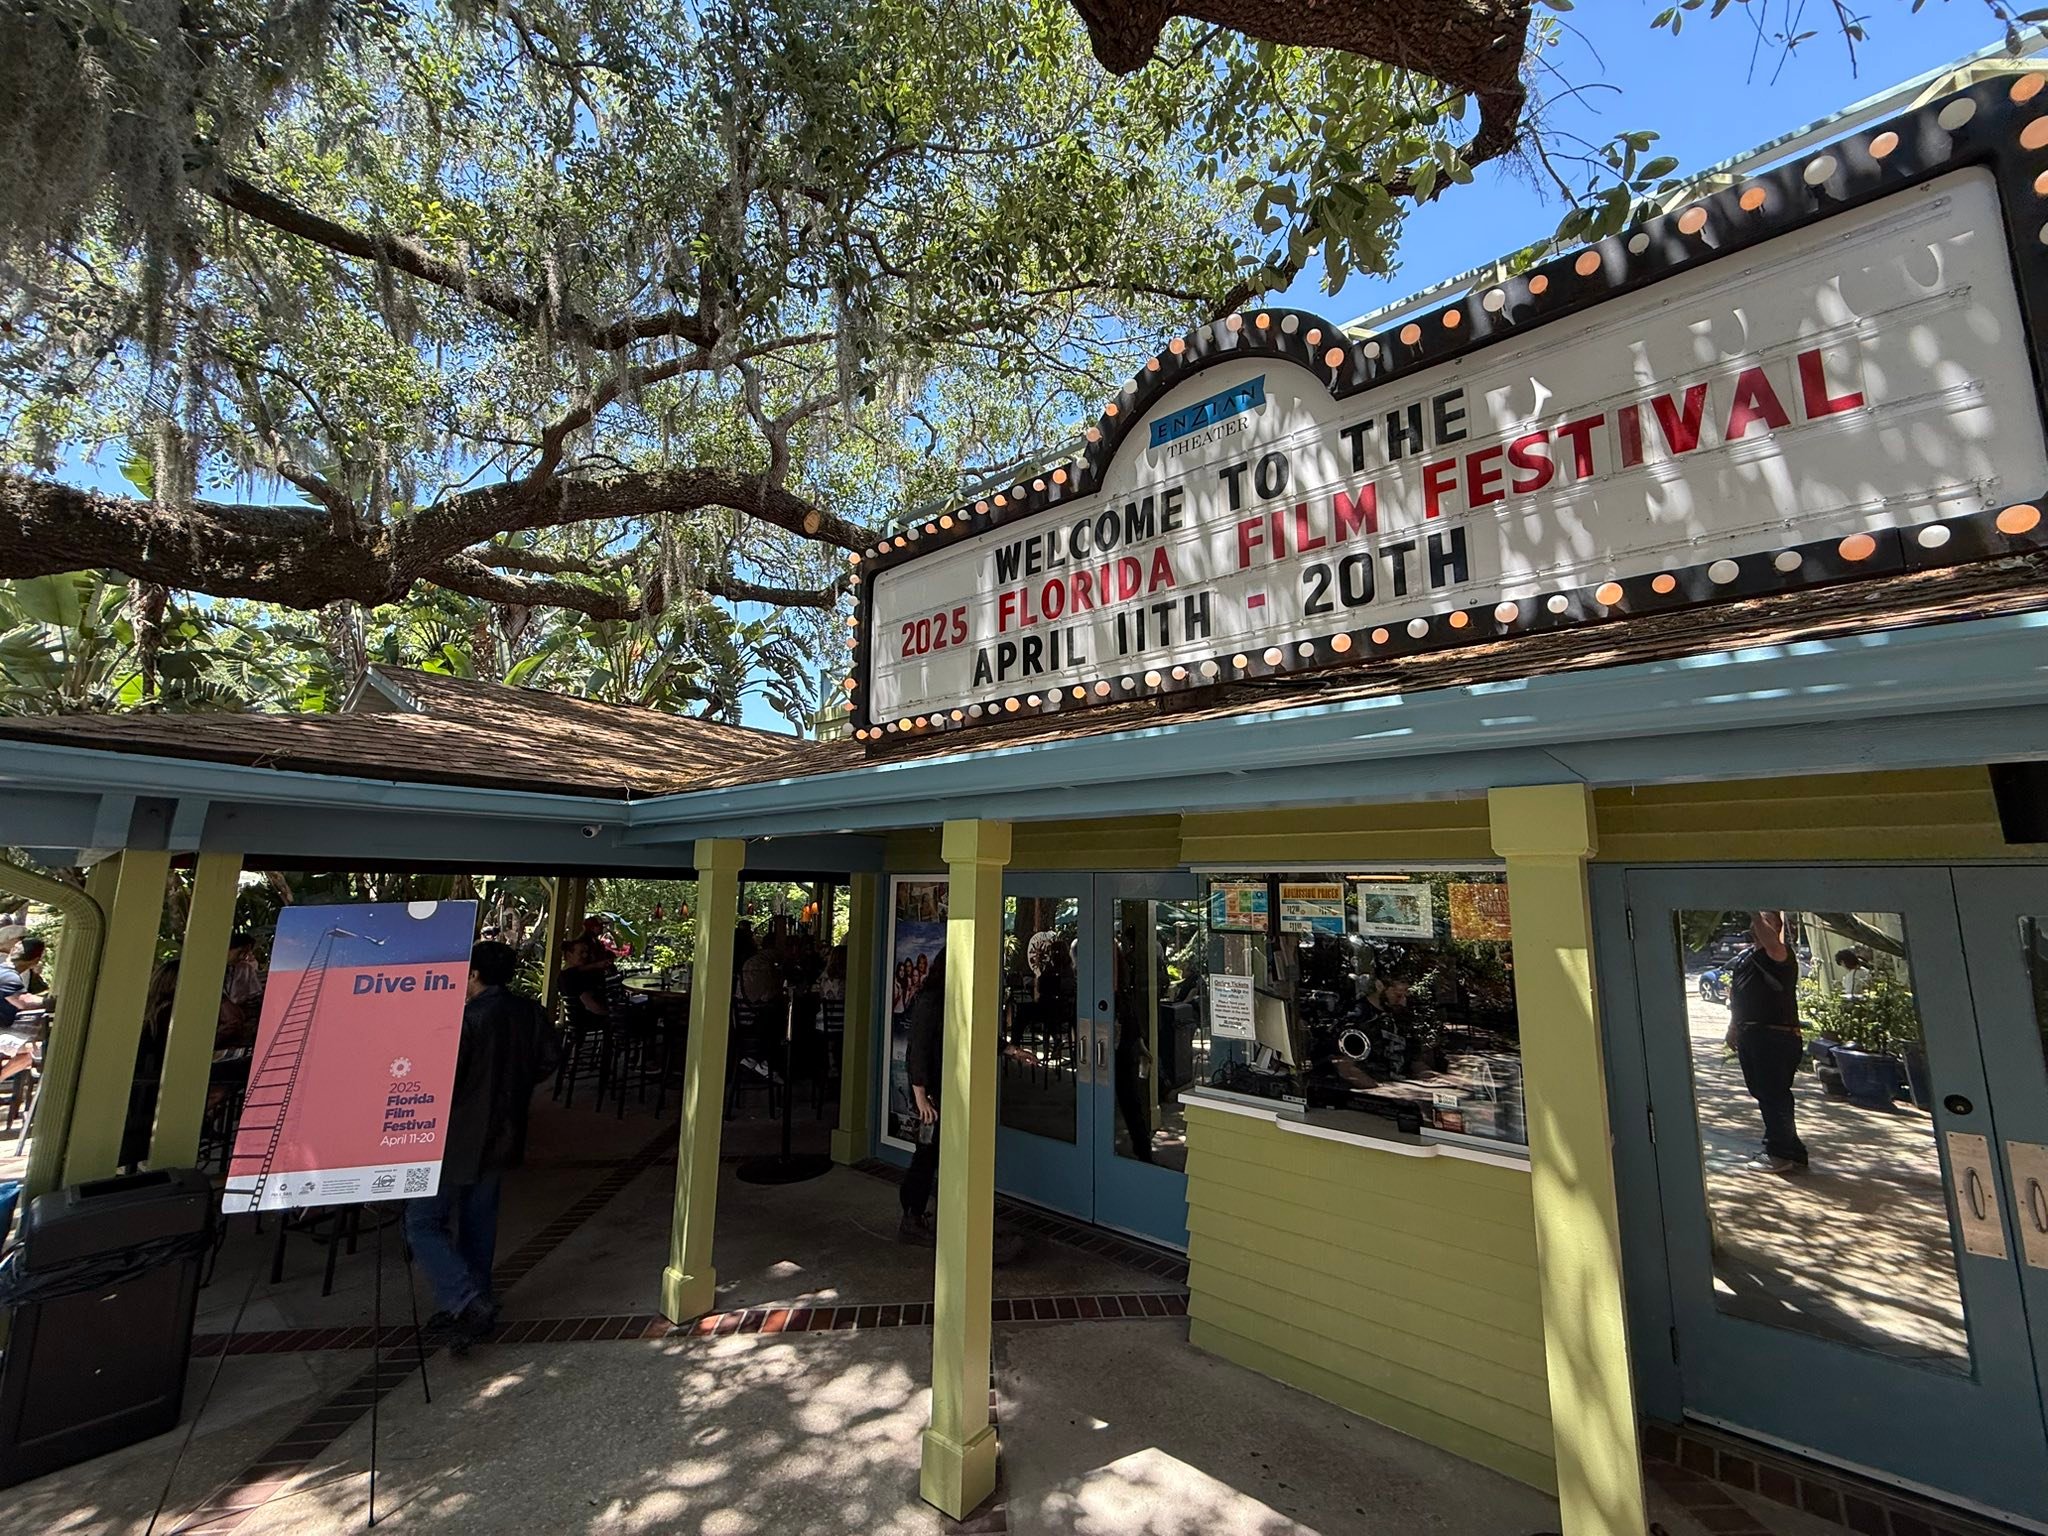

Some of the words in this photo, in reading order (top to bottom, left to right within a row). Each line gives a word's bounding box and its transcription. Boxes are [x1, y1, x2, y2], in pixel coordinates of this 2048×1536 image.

[1158, 385, 1255, 439] ENZIAN
[1167, 417, 1248, 458] THEATER
[996, 485, 1184, 584] WELCOME
[1219, 452, 1288, 511] TO
[1340, 388, 1467, 472] THE
[902, 606, 968, 657] 2025
[999, 546, 1176, 633] FLORIDA
[1237, 481, 1378, 569] FILM
[1424, 348, 1865, 520] FESTIVAL
[973, 627, 1086, 688] APRIL
[1302, 526, 1469, 616] 20TH
[353, 973, 416, 995] Dive
[424, 970, 456, 991] in.
[387, 1093, 434, 1106] Florida
[389, 1081, 421, 1093] 2025
[383, 1118, 436, 1132] Festival
[385, 1107, 415, 1119] Film
[380, 1134, 407, 1147] April
[409, 1132, 435, 1143] 11-20
